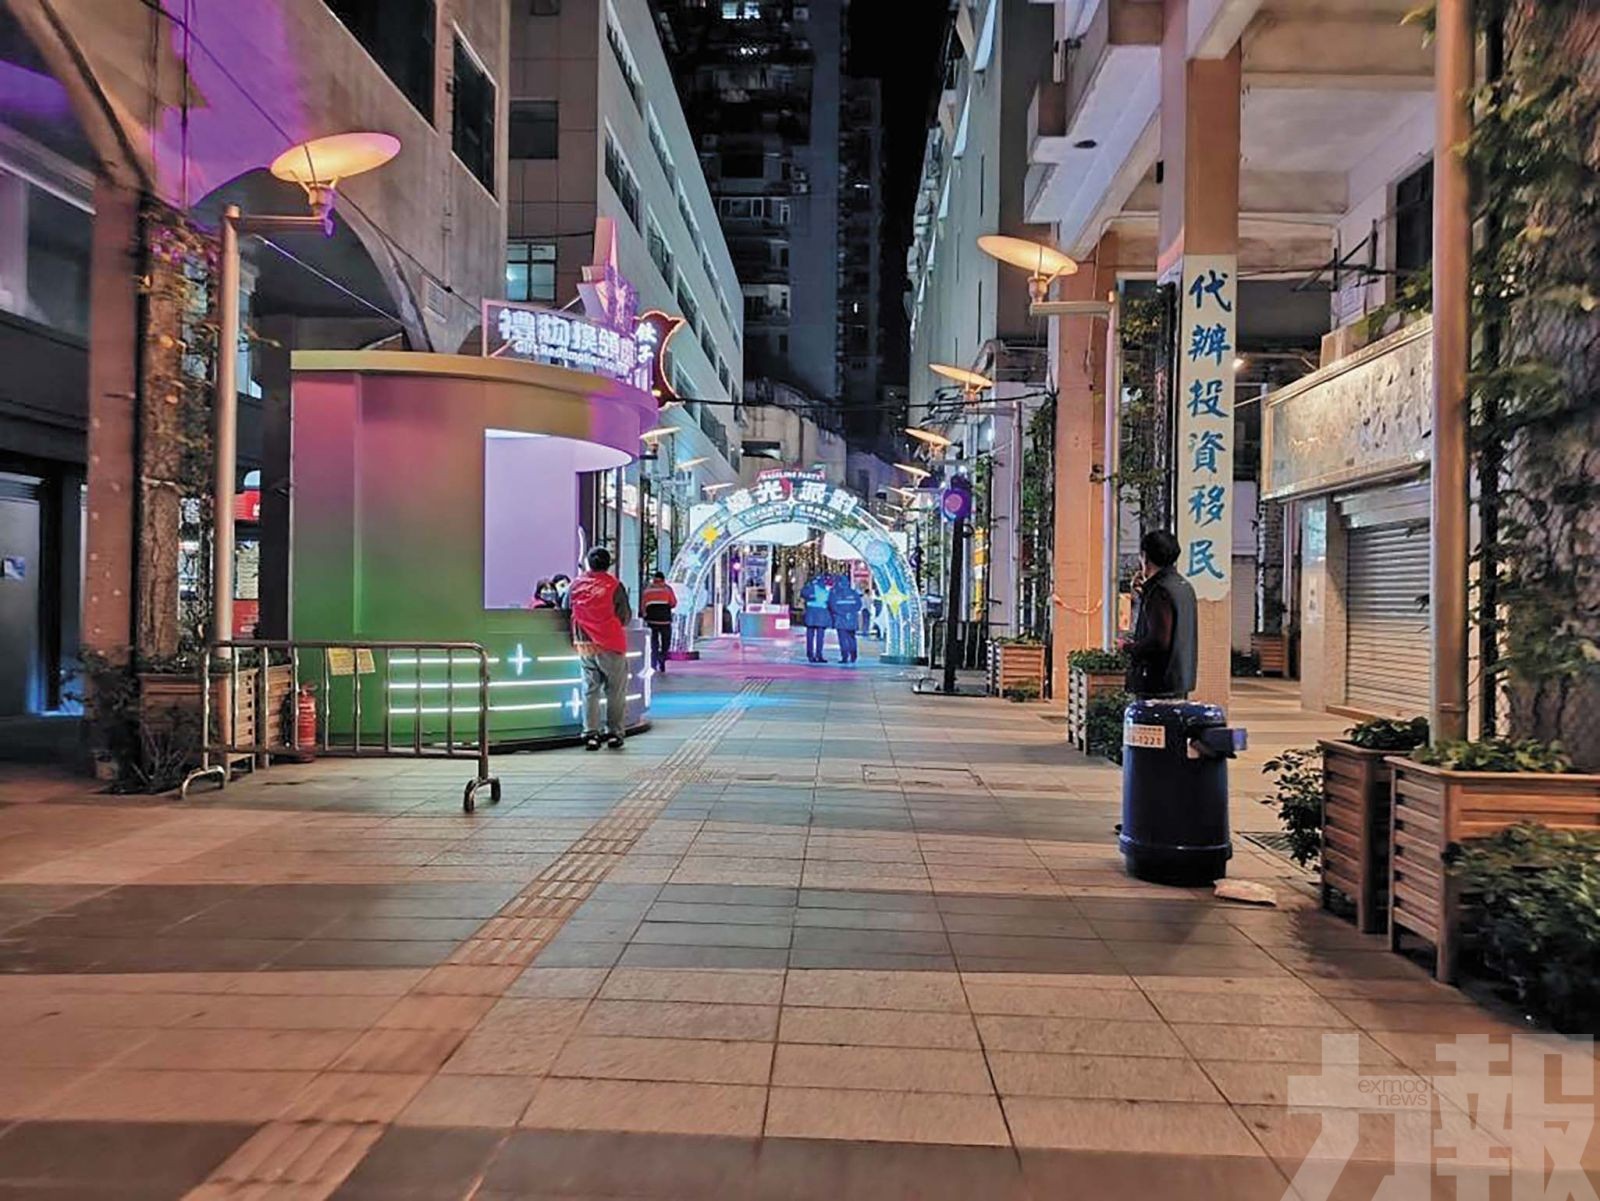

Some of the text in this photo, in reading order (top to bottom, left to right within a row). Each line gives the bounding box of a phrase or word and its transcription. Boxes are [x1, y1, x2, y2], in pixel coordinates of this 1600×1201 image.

[1187, 270, 1232, 580] 代辦投資移民
